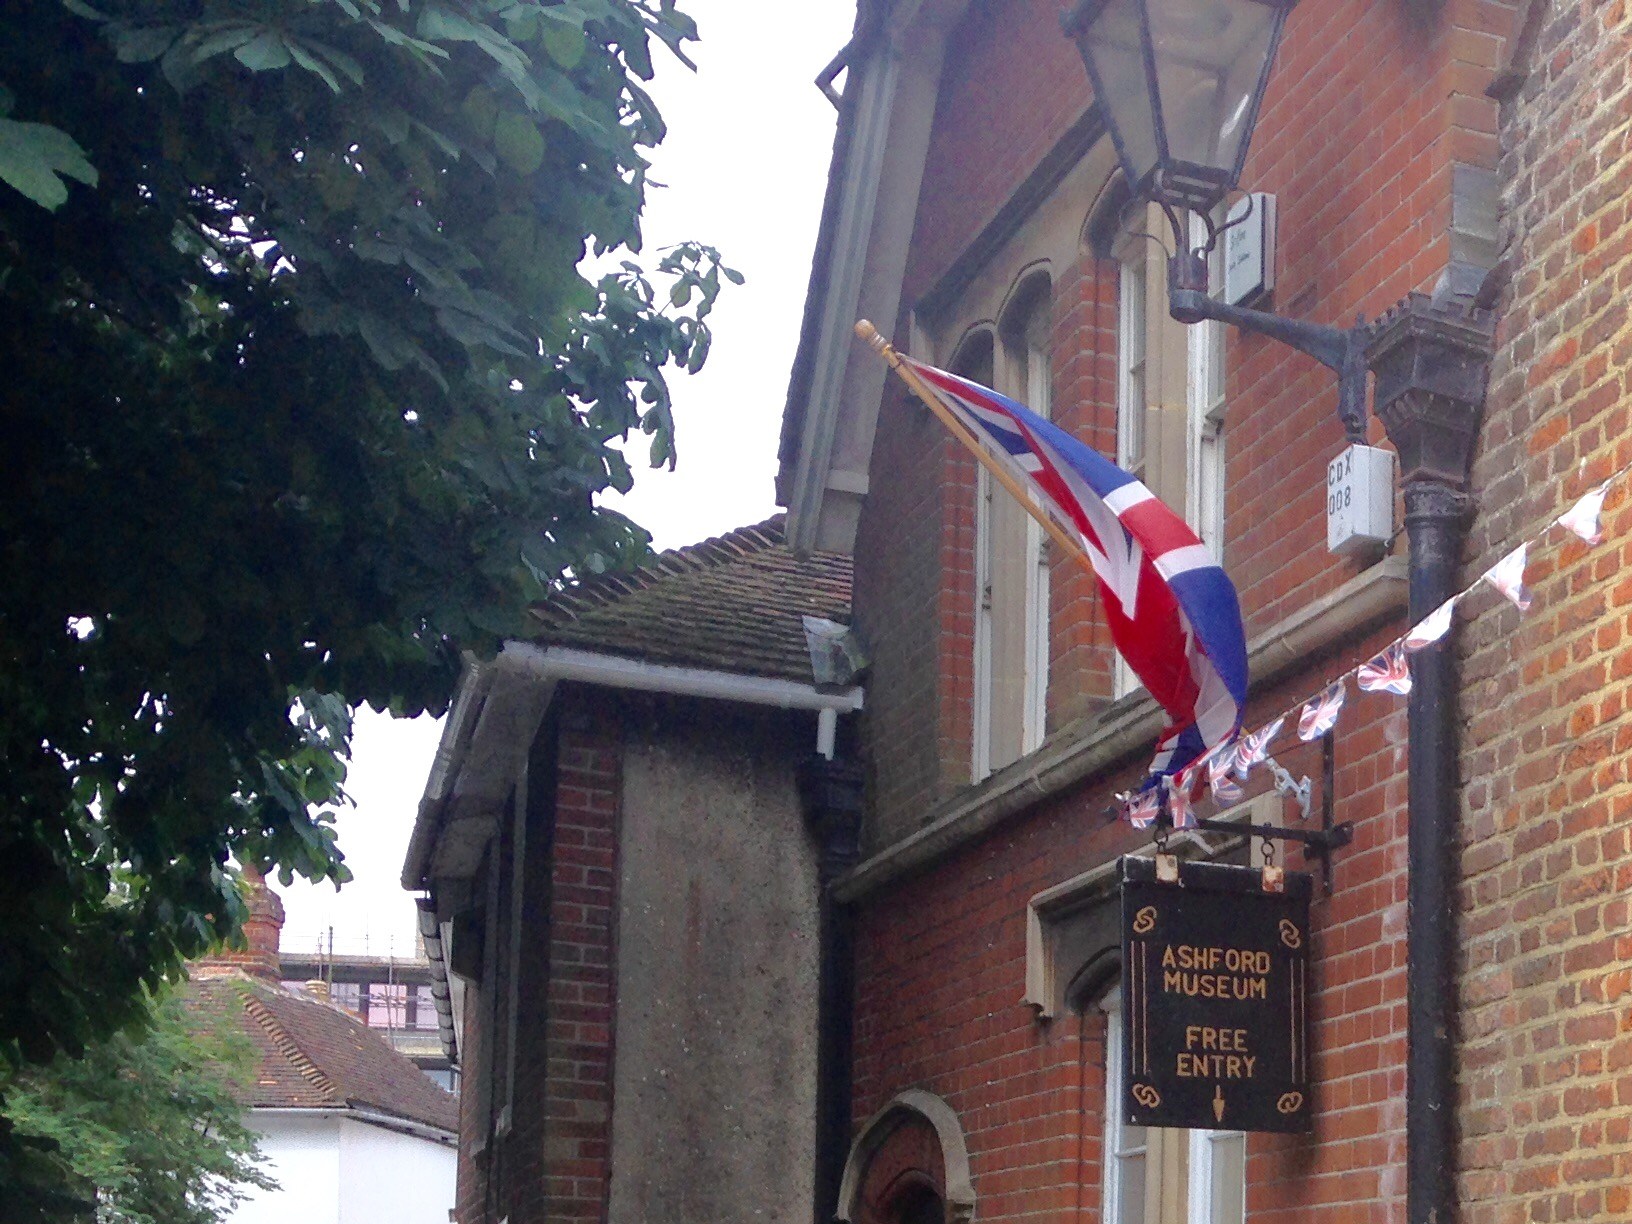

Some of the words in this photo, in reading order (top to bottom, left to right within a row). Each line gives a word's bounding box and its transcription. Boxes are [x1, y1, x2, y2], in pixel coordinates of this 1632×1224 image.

[1328, 452, 1352, 487] CDX
[1328, 485, 1352, 516] 008
[1161, 944, 1271, 974] ASHFORD
[1163, 971, 1267, 1000] MUSEUM
[1185, 1025, 1249, 1052] FREE
[1176, 1053, 1257, 1079] ENTRY
